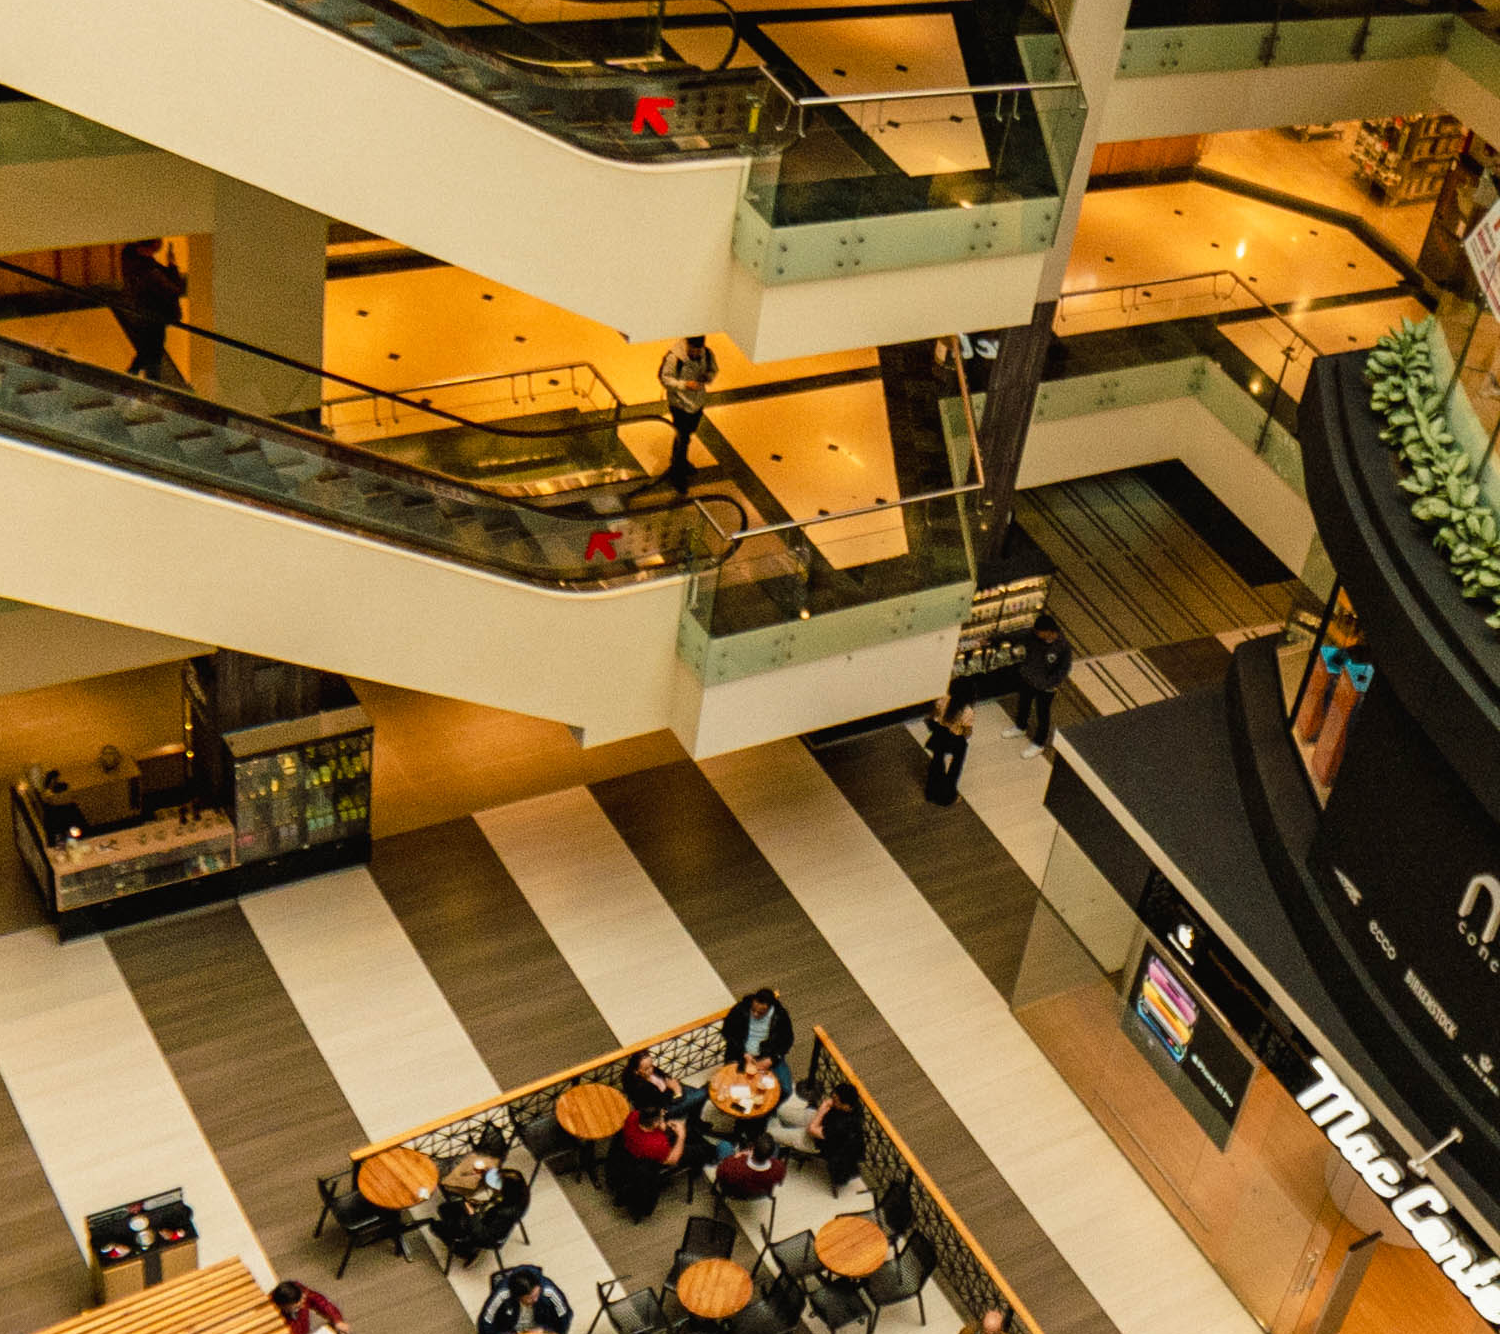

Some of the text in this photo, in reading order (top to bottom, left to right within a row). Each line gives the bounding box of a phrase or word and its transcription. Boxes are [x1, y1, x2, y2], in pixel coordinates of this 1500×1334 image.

[1368, 919, 1397, 961] ecco
[1403, 967, 1459, 1041] BIRKENSTOCK
[1296, 1055, 1405, 1200] Mac
